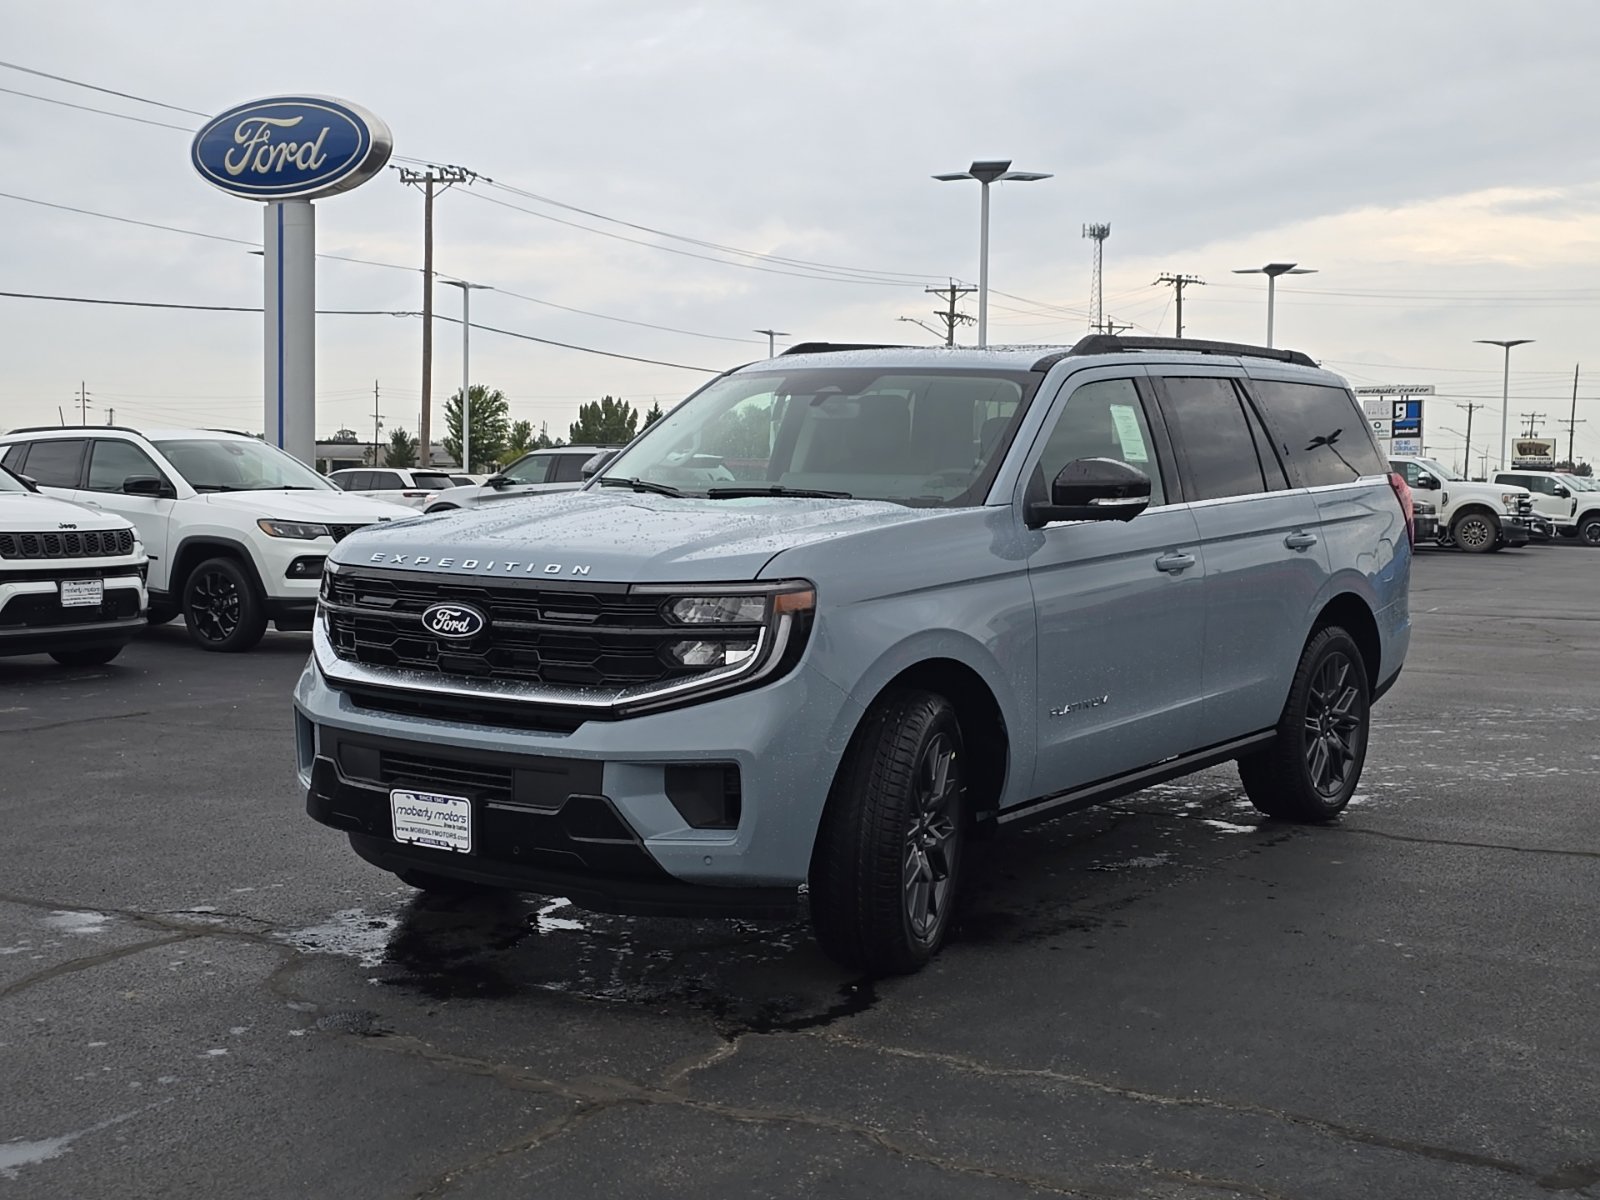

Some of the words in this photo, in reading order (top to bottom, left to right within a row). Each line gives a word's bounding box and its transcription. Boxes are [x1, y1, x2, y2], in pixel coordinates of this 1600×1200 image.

[224, 116, 330, 176] Ford
[369, 552, 592, 576] EXPEDITION
[431, 608, 471, 634] Ford
[396, 805, 433, 821] moberly
[434, 810, 467, 824] motors
